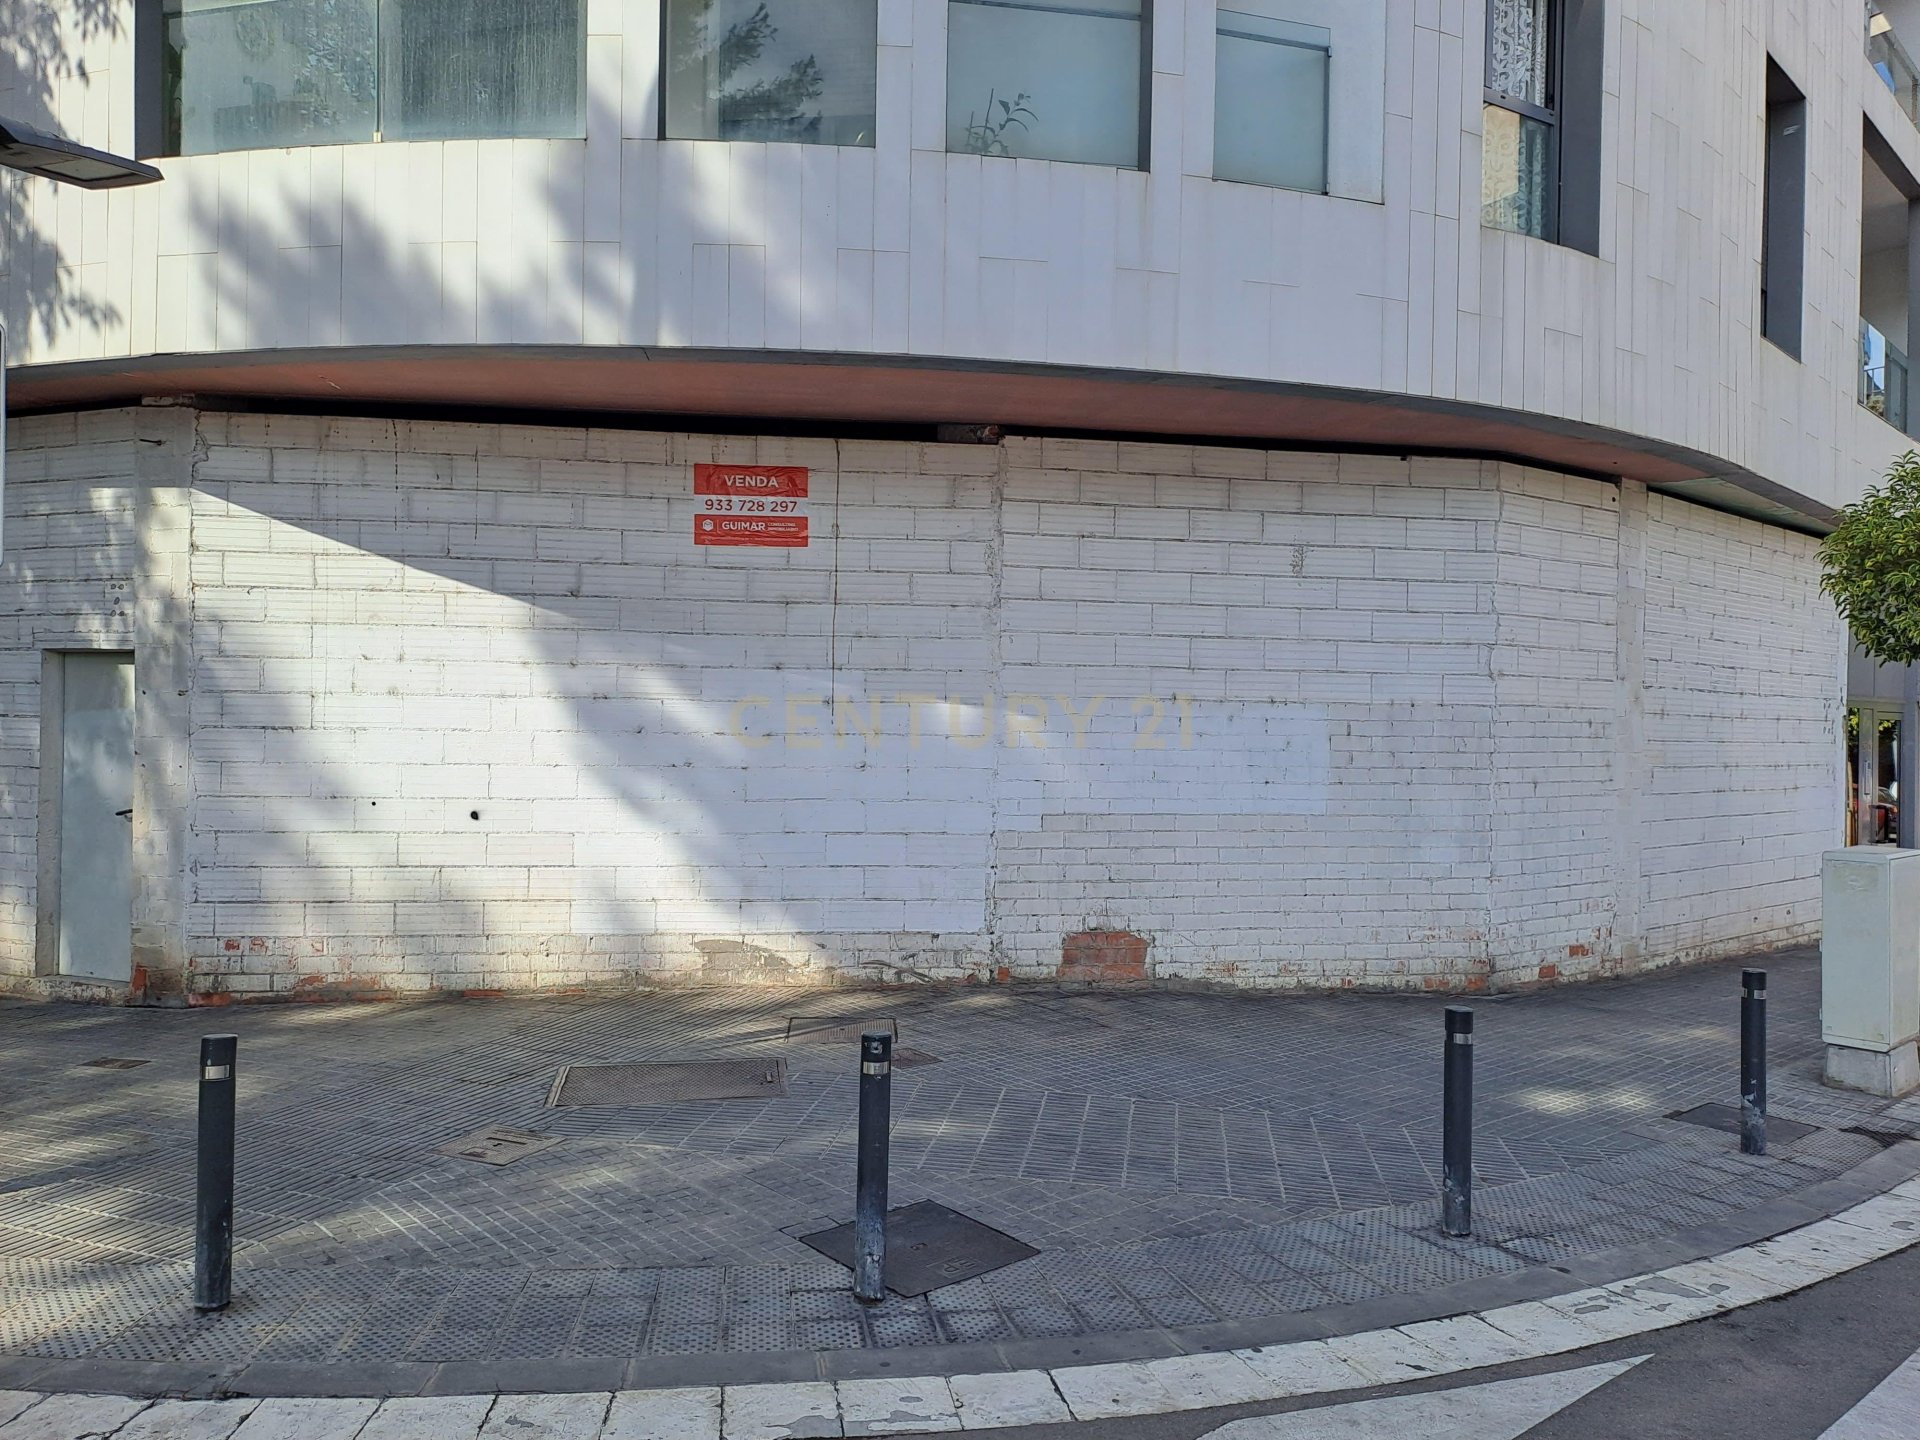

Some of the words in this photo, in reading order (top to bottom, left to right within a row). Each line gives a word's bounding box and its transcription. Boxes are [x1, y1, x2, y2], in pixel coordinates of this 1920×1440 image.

[725, 475, 779, 488] VENDA
[704, 499, 733, 511] 933
[738, 500, 765, 512] 728
[770, 501, 798, 512] 297
[722, 522, 766, 531] GUIMAR
